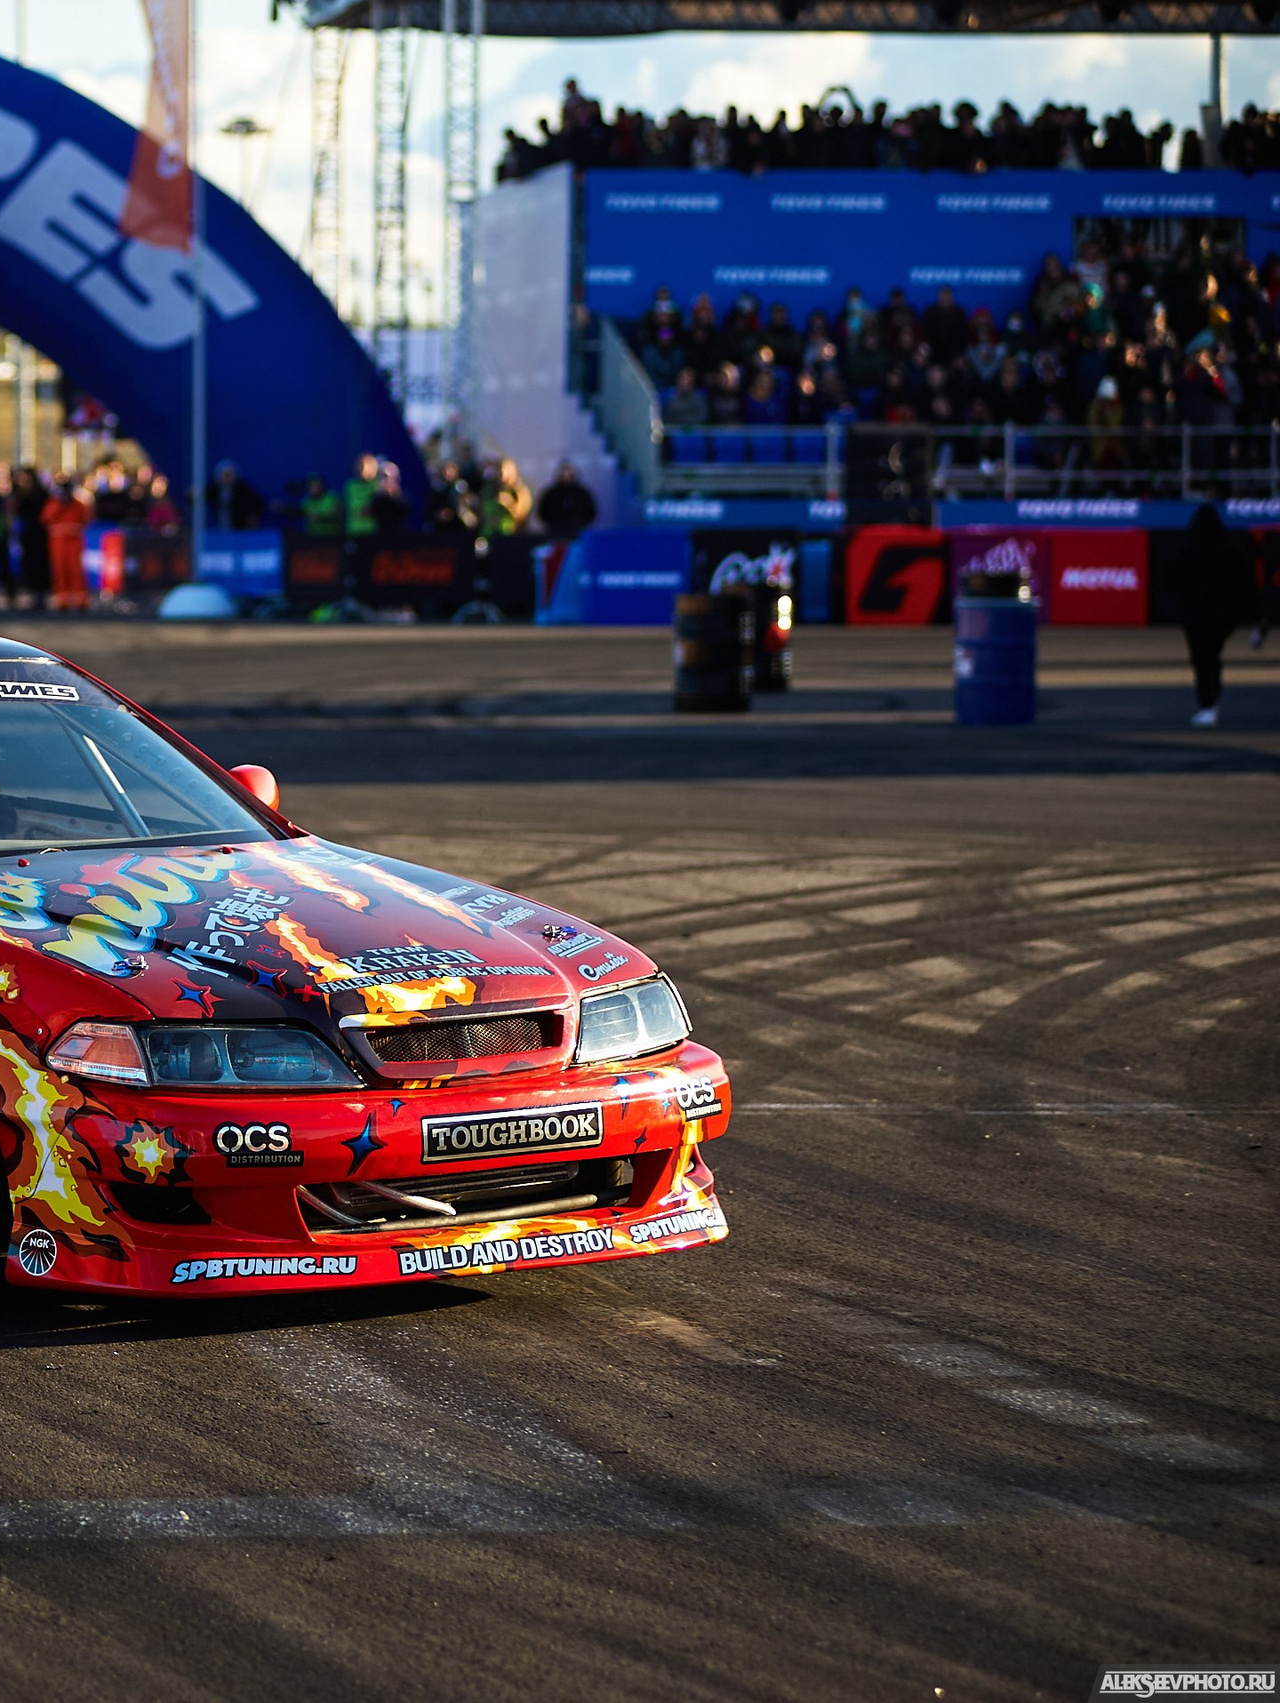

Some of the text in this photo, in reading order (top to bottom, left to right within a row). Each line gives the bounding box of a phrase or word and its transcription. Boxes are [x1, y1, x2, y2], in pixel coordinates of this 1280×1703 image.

[339, 950, 485, 972] KRAKEN
[366, 945, 428, 955] TEAM
[318, 966, 552, 993] FALLEN OUT OF PUBLIC OPINION
[677, 1077, 715, 1108] OCS
[217, 1125, 289, 1153] OCS
[432, 1113, 598, 1151] TOUGHBOOK
[231, 1154, 301, 1164] DISTRIBUTION
[30, 1237, 50, 1249] NGK
[400, 1229, 615, 1275] BUILD AND DESTROY
[172, 1256, 358, 1284] SPBTUNING.RU
